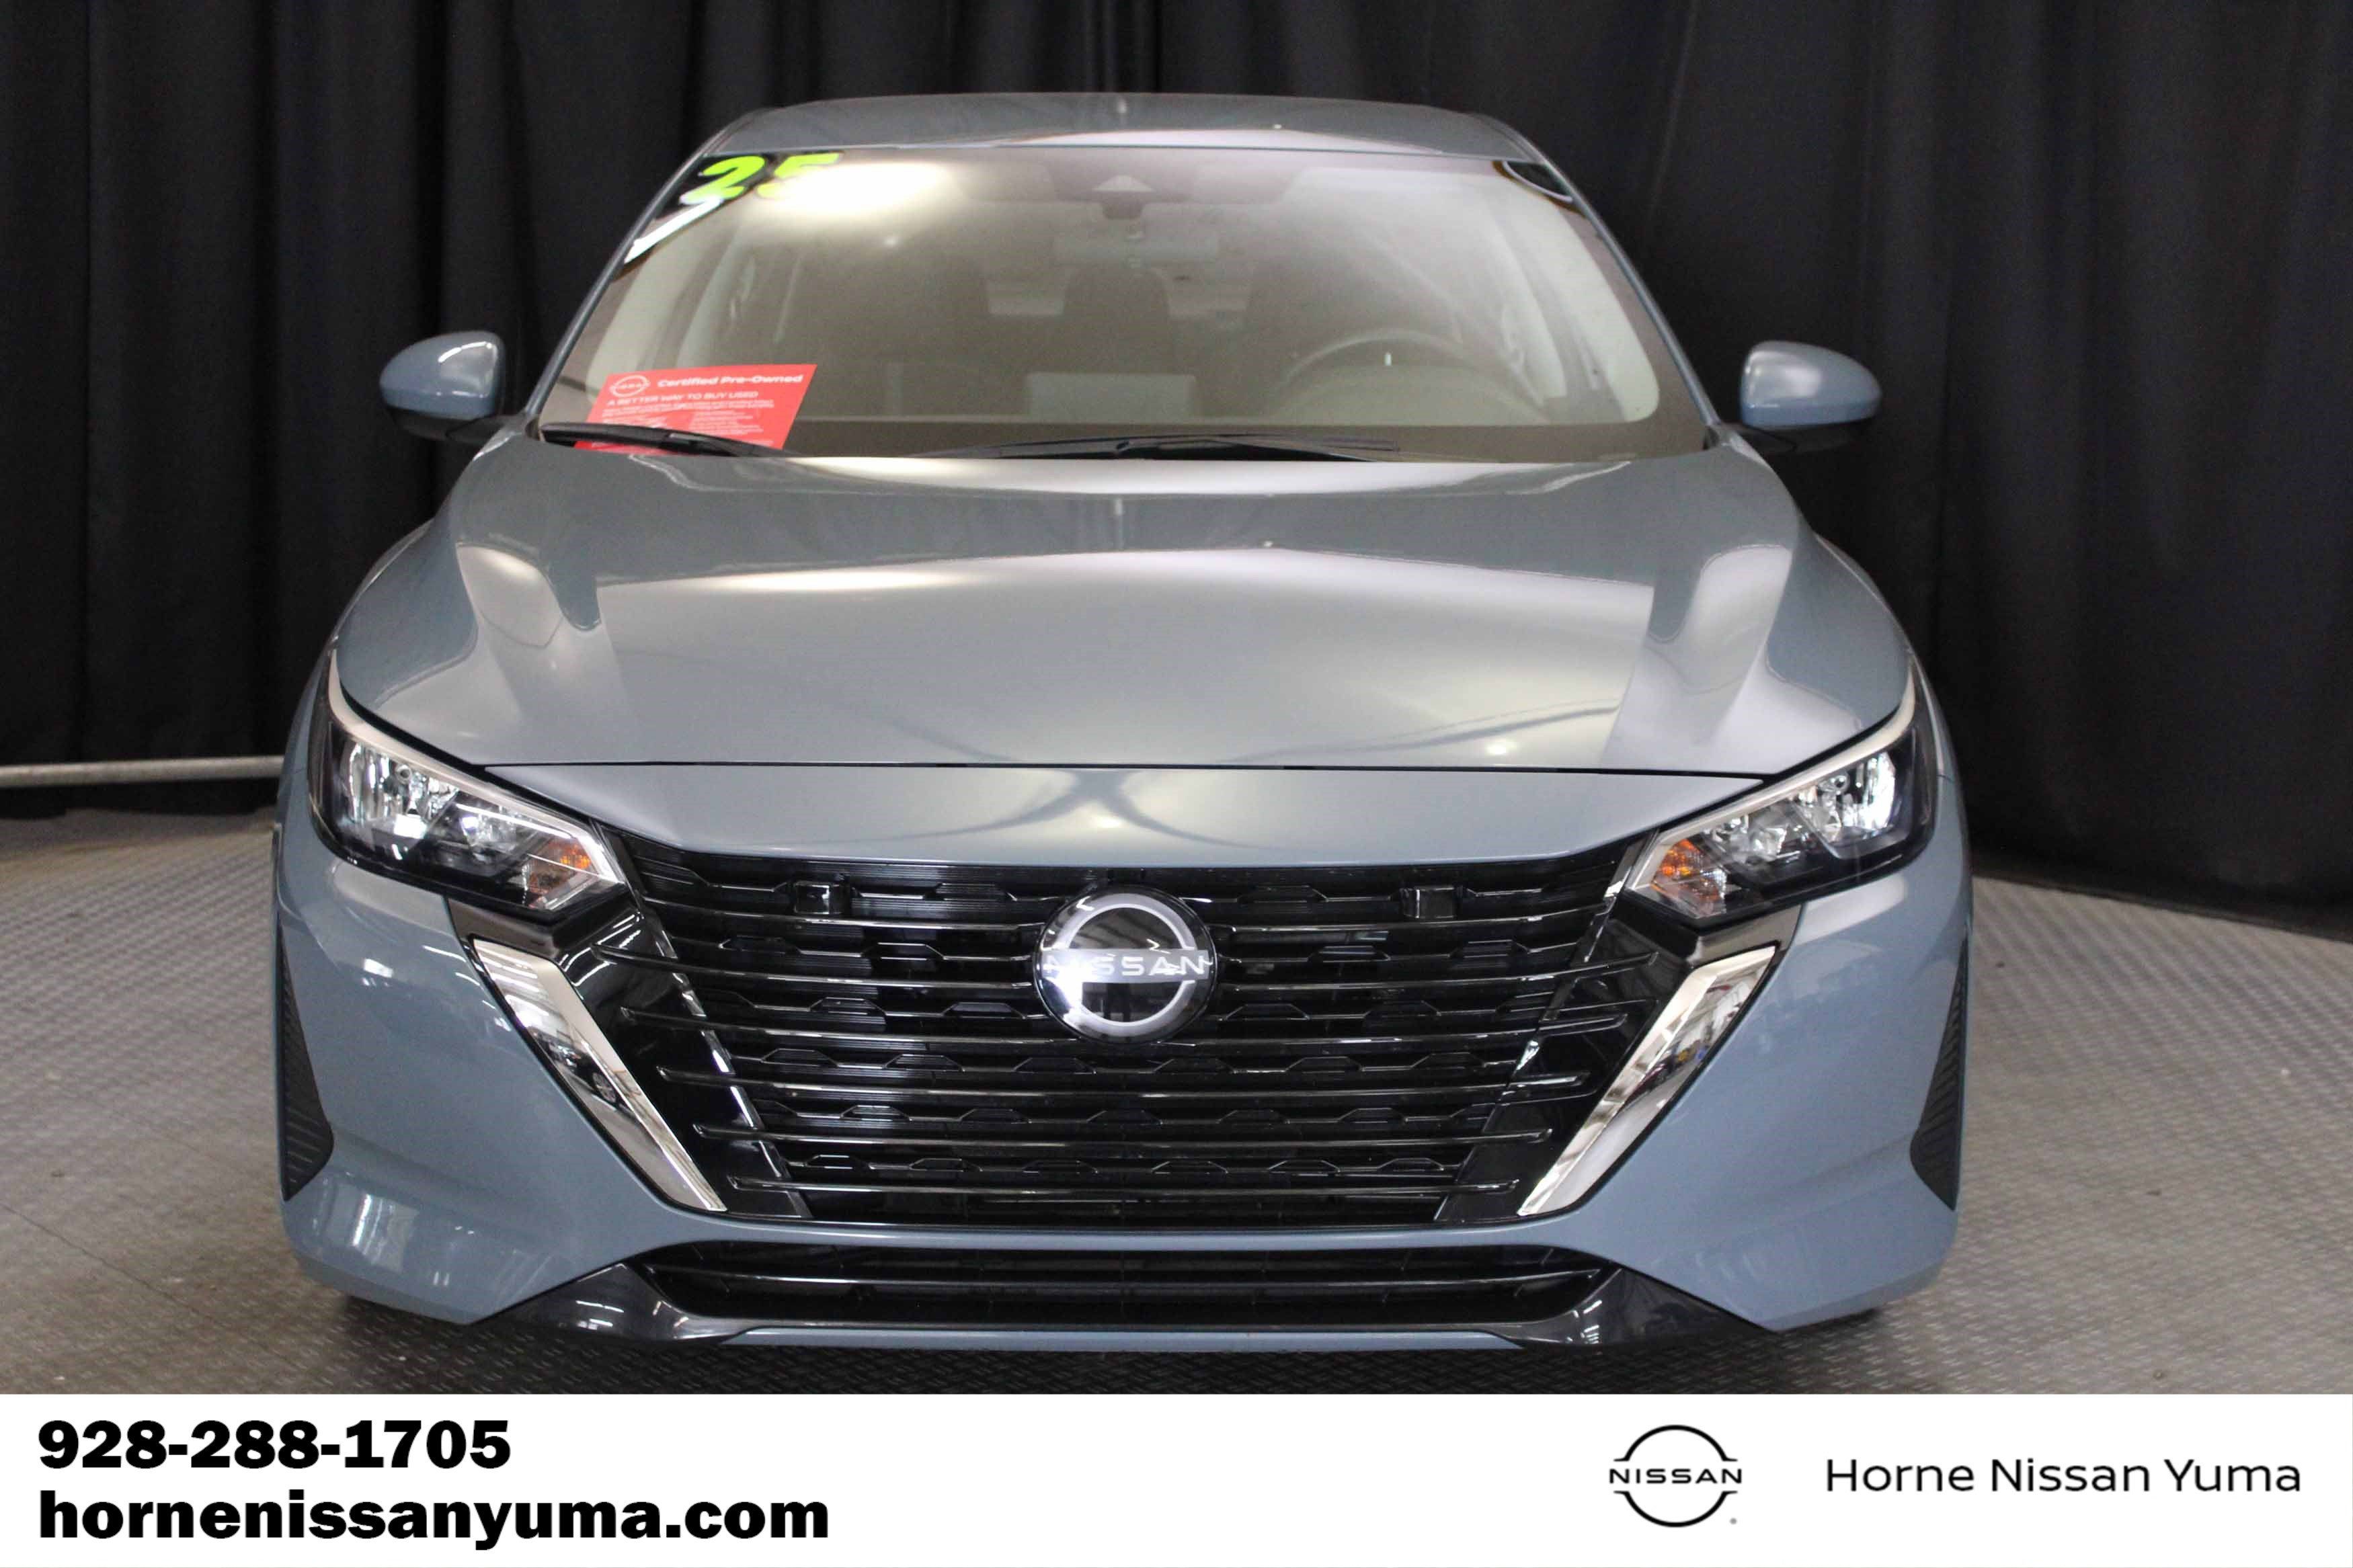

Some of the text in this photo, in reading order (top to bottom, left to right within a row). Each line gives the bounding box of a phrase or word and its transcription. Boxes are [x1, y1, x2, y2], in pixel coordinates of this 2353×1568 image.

[657, 376, 719, 388] Certified
[721, 374, 803, 384] Pre-Owned
[616, 395, 659, 405] BETTER
[661, 394, 685, 402] WAY
[728, 390, 759, 399] USED
[1043, 956, 1204, 975] NSSAN
